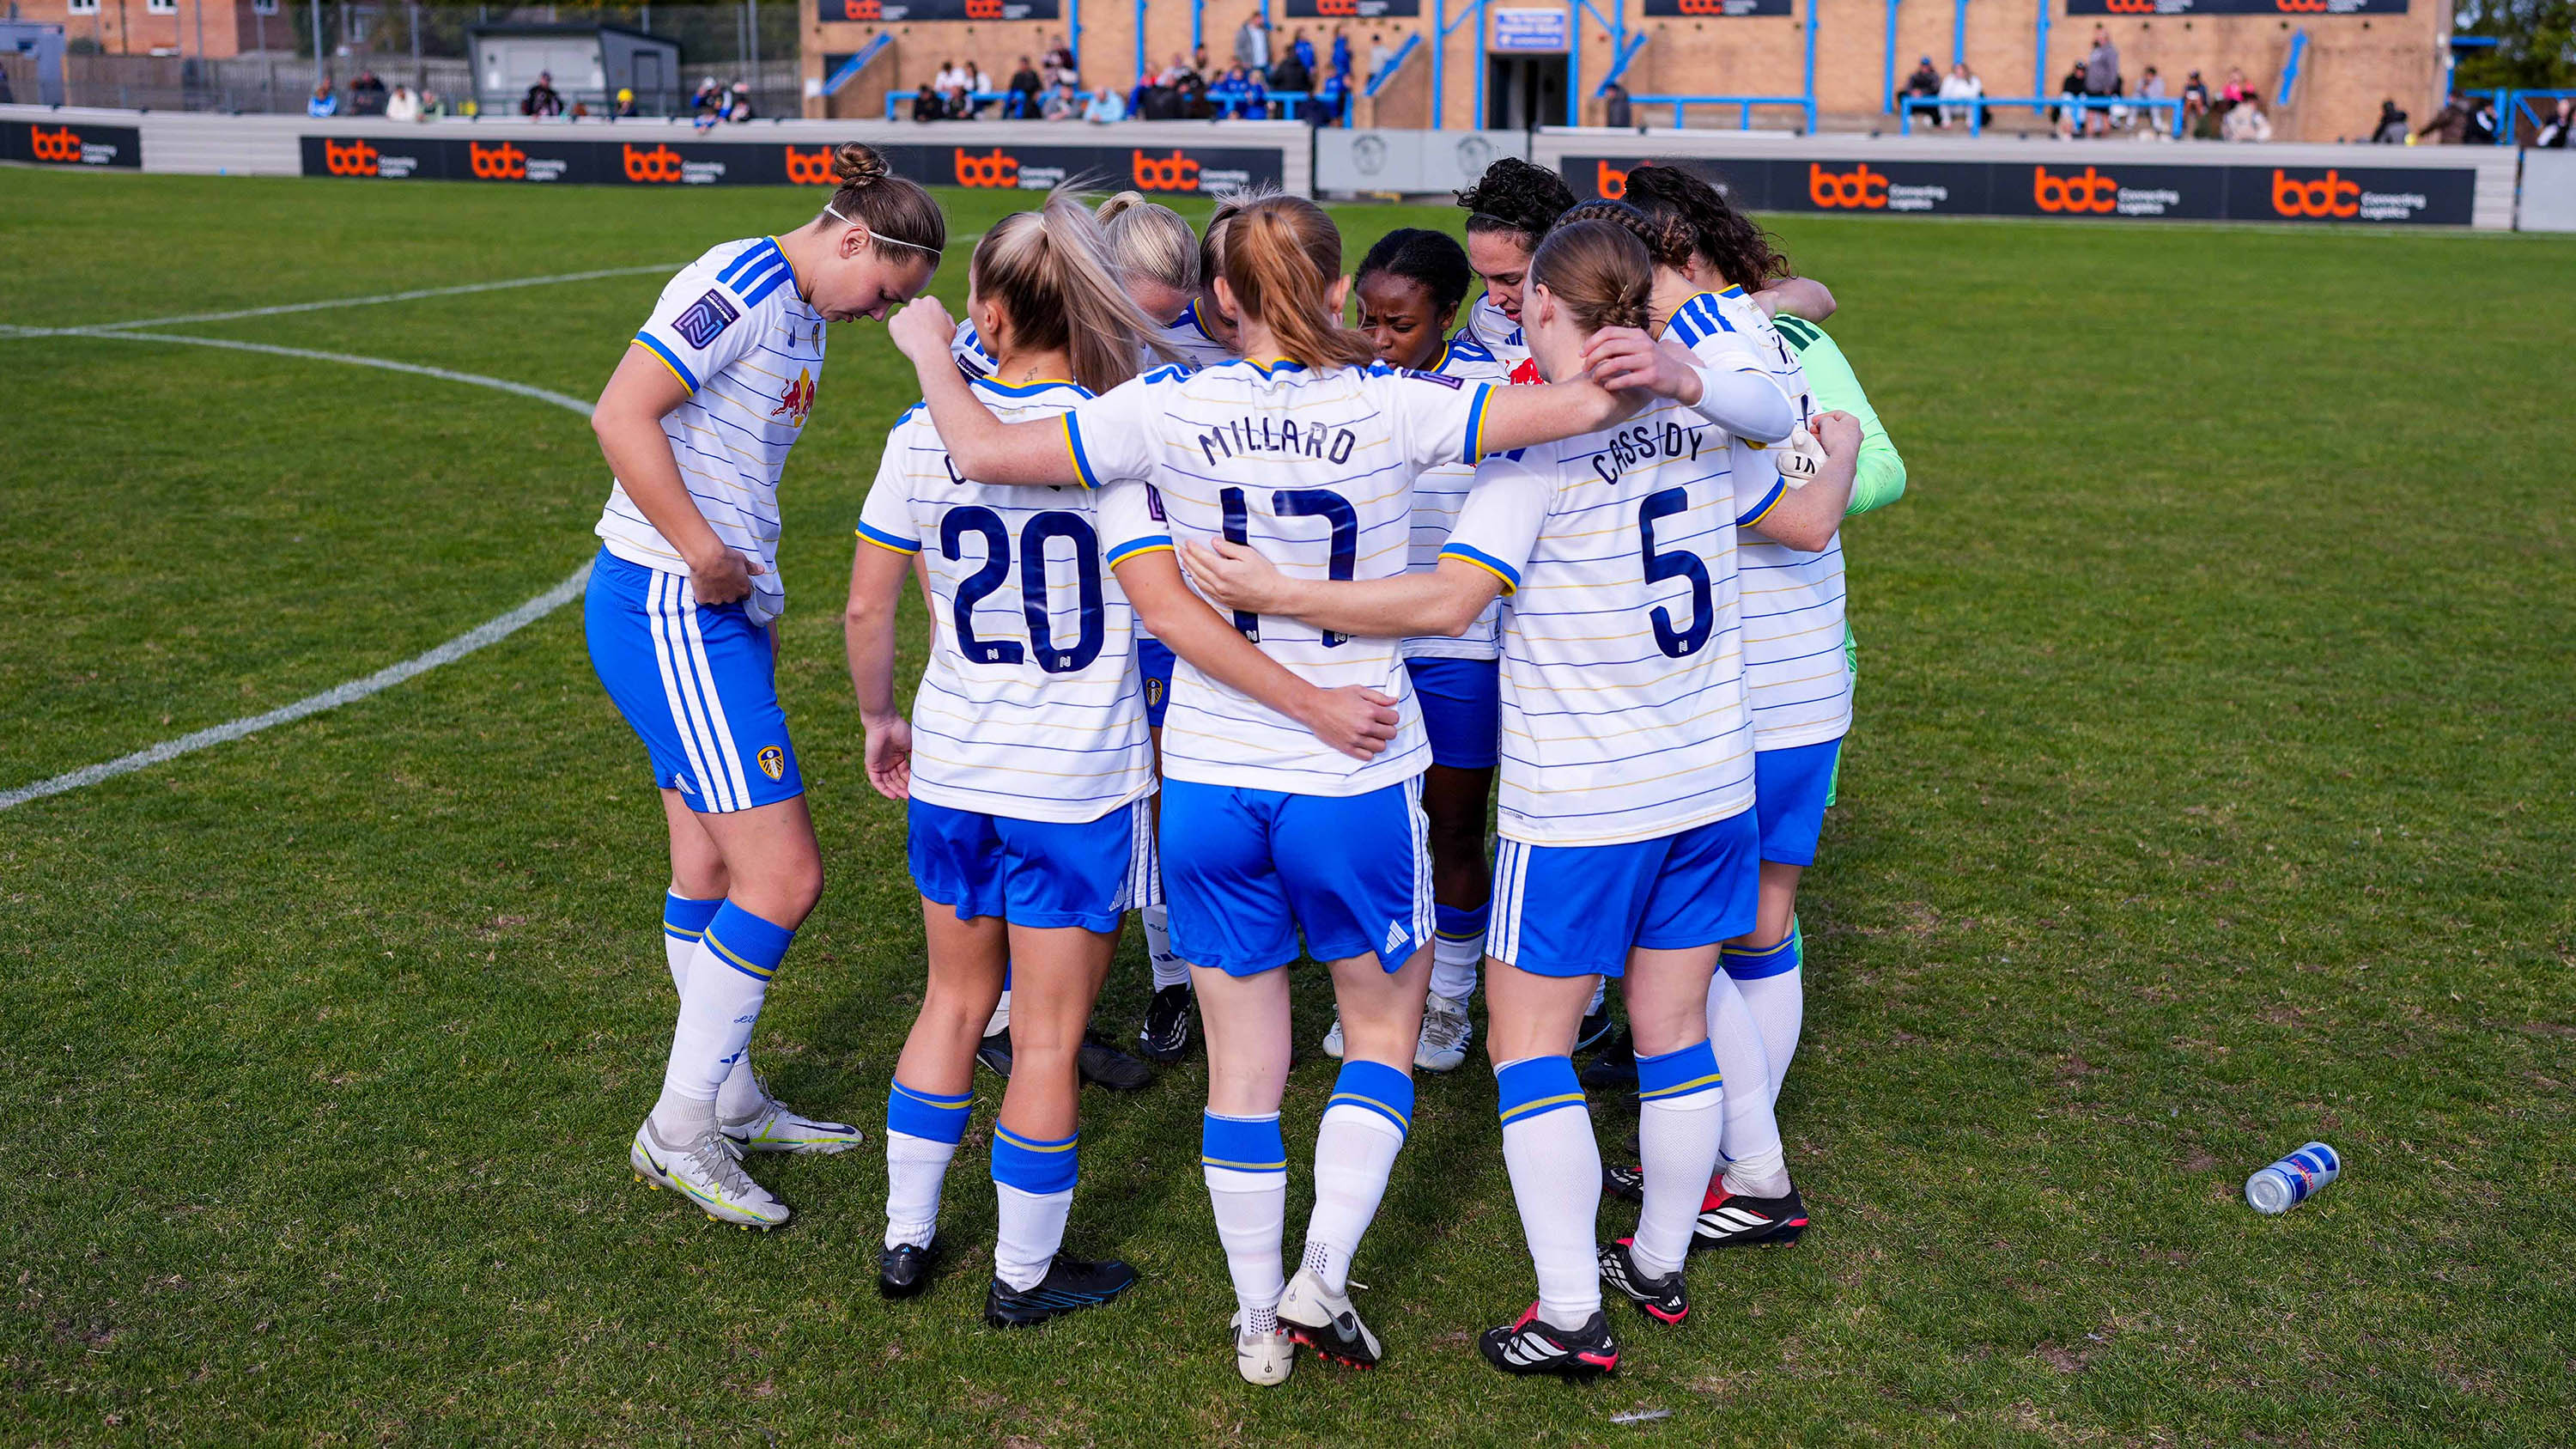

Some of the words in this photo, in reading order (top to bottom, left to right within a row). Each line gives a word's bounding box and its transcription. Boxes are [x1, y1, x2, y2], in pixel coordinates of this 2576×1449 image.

[32, 125, 81, 161] bdc
[325, 138, 378, 176] bdc
[471, 141, 526, 179] bdc
[623, 143, 682, 181] bdc
[955, 148, 1018, 187] bdc
[1133, 149, 1199, 191] bdc
[1810, 162, 1887, 208] bdc
[2034, 166, 2117, 212] bdc
[2272, 169, 2360, 217] bdc
[1198, 416, 1356, 466] MILLARD
[1592, 421, 1703, 485] CASSIDY
[939, 505, 1104, 673] 20
[1219, 486, 1358, 648] 17
[1638, 486, 1714, 659] 5
